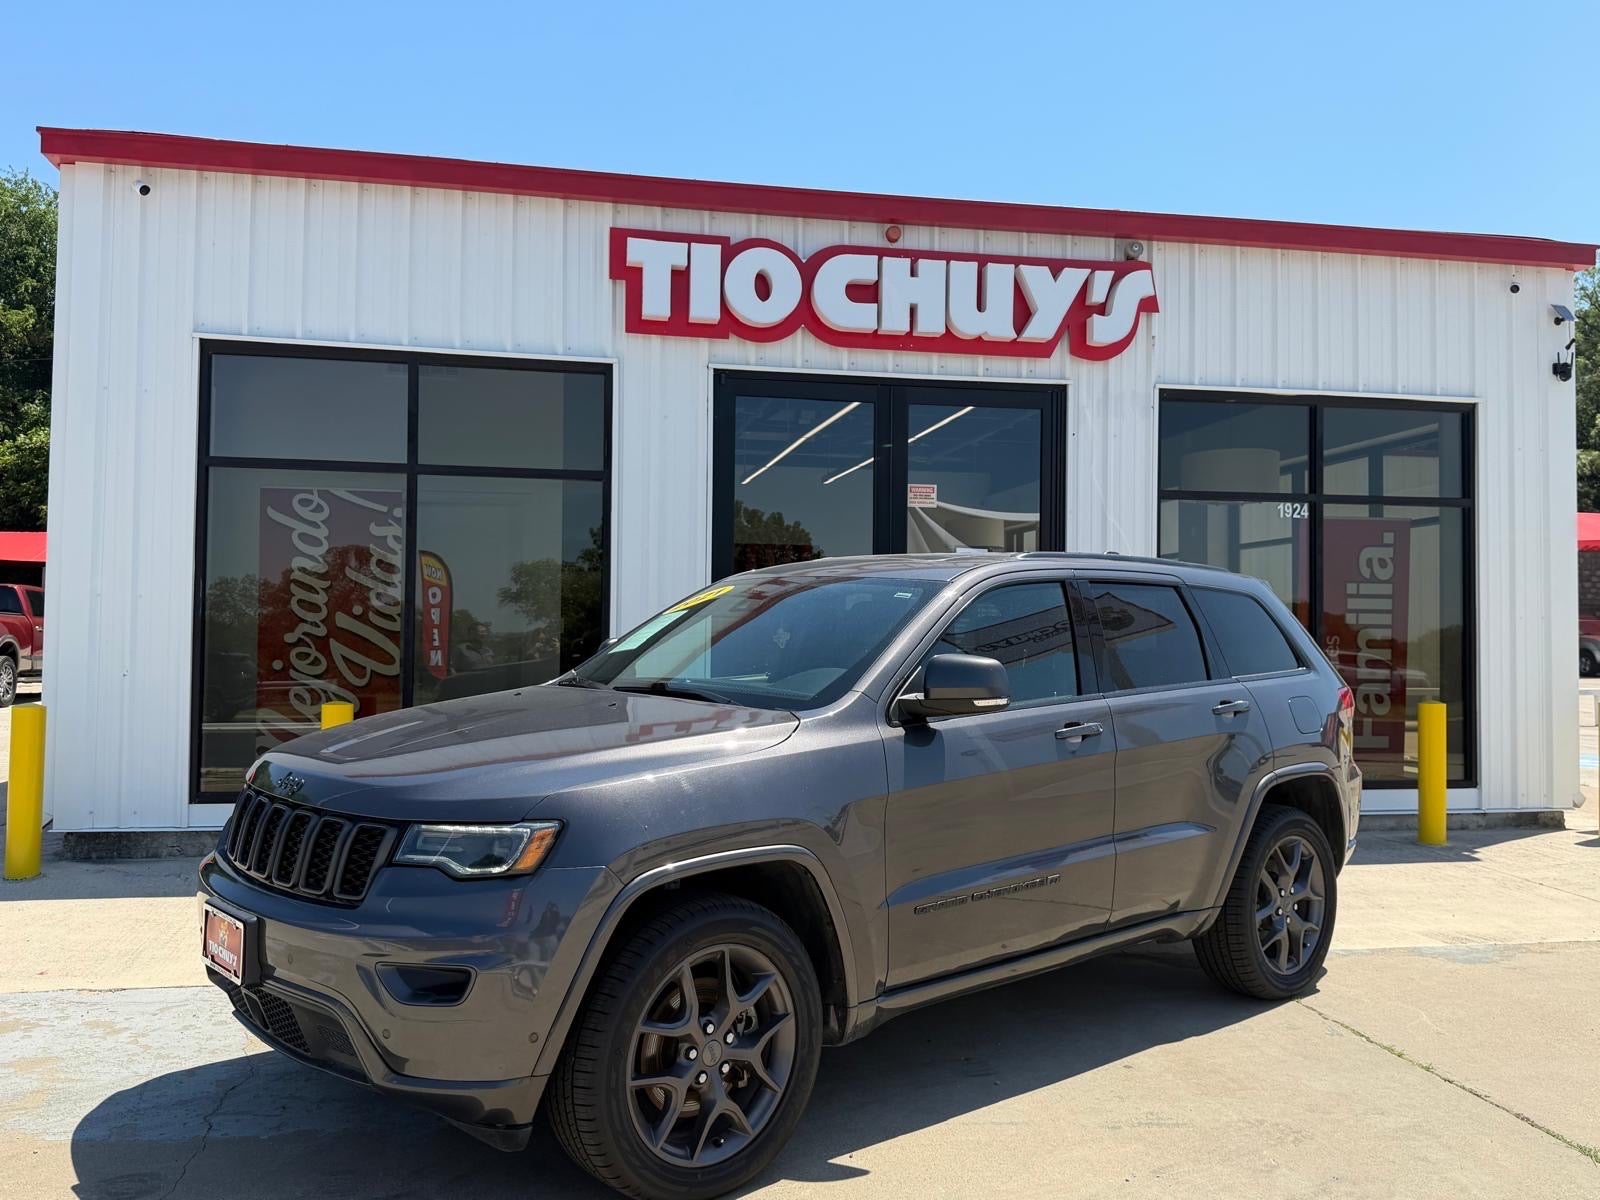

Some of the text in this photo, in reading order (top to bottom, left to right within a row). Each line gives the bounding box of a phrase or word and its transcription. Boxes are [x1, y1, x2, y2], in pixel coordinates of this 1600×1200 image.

[626, 237, 1155, 347] TIO CHUY'S
[1277, 503, 1309, 519] 1924
[1345, 531, 1396, 749] Familia.
